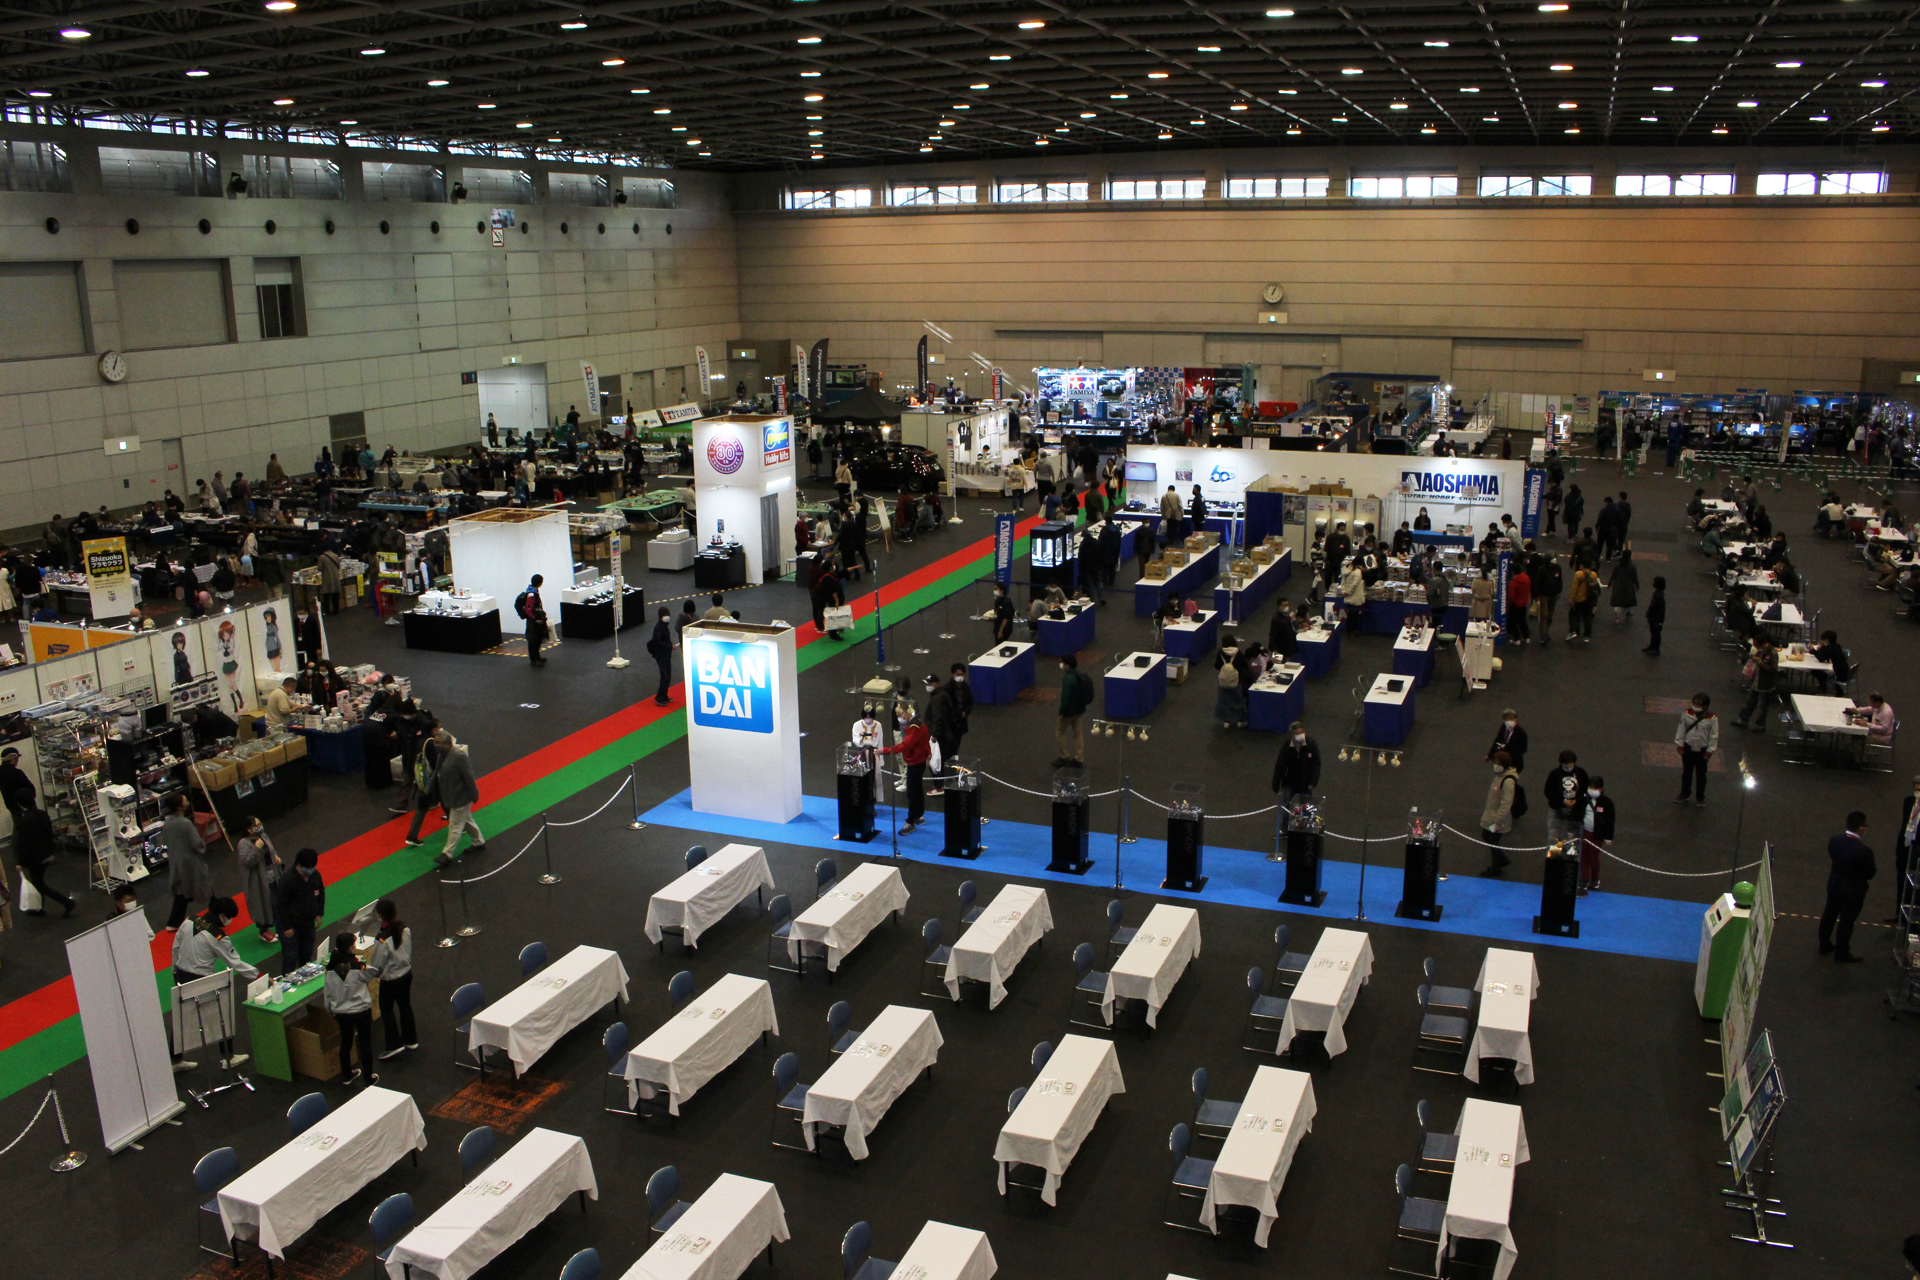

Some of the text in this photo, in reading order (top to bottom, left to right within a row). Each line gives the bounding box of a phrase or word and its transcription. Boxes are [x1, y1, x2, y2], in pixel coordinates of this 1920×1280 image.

[674, 407, 698, 418] TAMIYA
[716, 446, 735, 460] 80
[766, 453, 779, 464] Hobby
[1422, 472, 1499, 495] AOSHIMA
[997, 531, 1009, 569] AOSHIMA
[90, 554, 122, 563] Shizuoka
[91, 560, 123, 569] プラモクラブ
[697, 651, 766, 689] BAN
[700, 685, 752, 719] DAI
